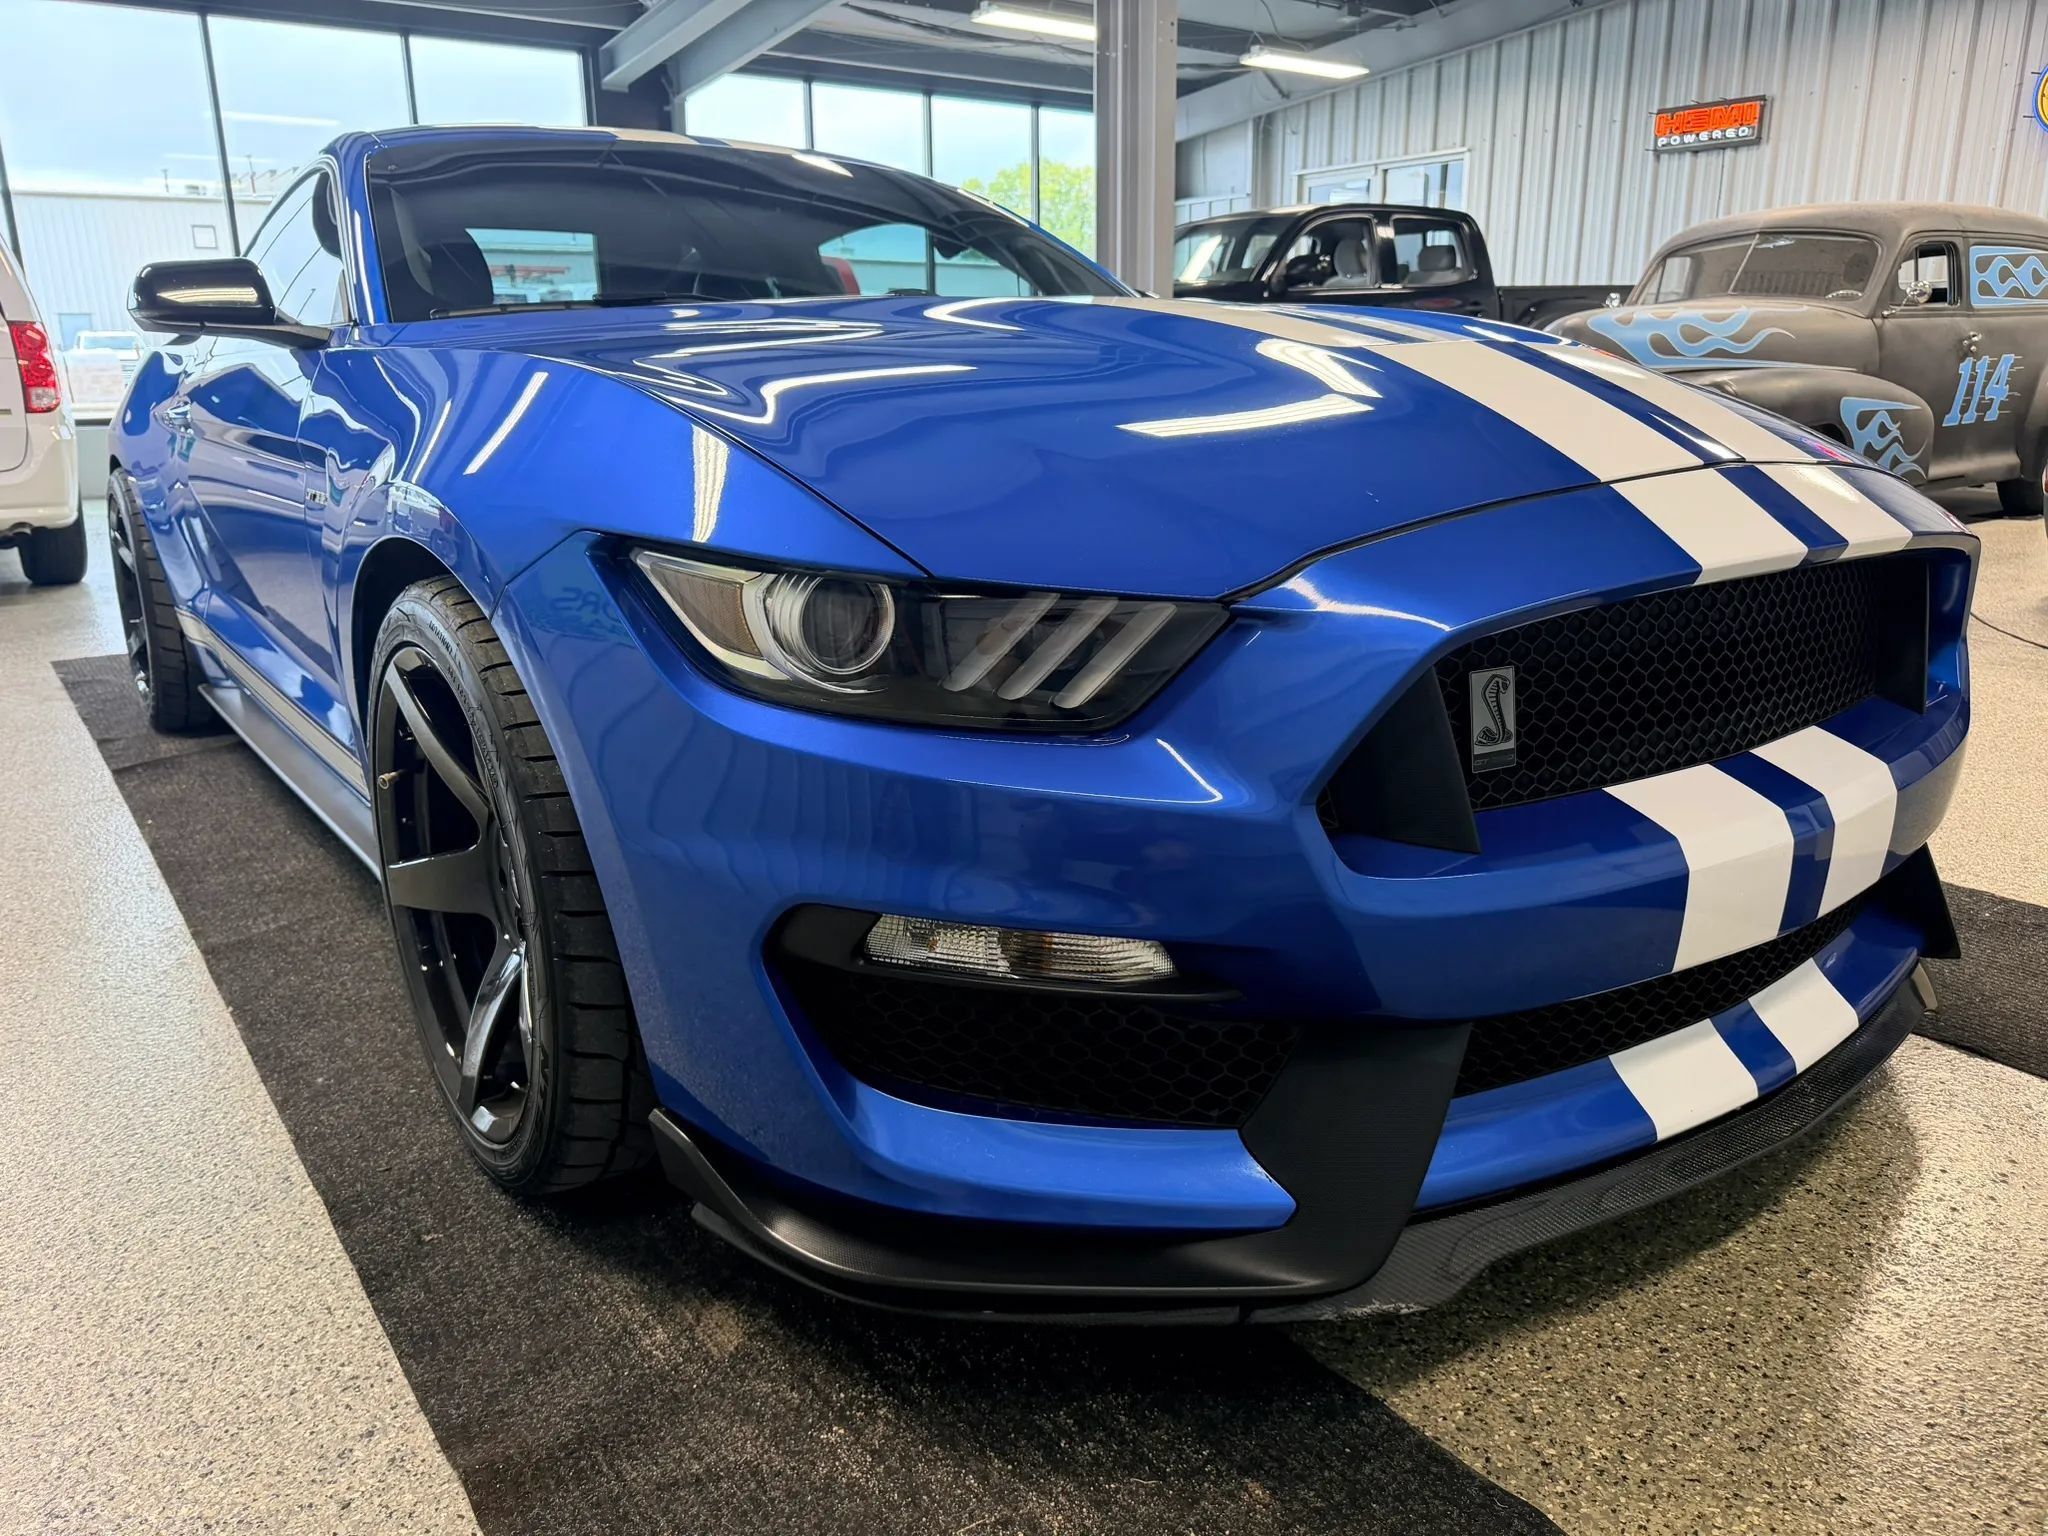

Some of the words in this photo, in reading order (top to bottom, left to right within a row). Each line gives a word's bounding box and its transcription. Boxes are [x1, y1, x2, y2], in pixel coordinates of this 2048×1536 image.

[1655, 102, 1760, 136] HEMI
[1657, 126, 1752, 147] POWERED
[1942, 354, 2015, 426] 114
